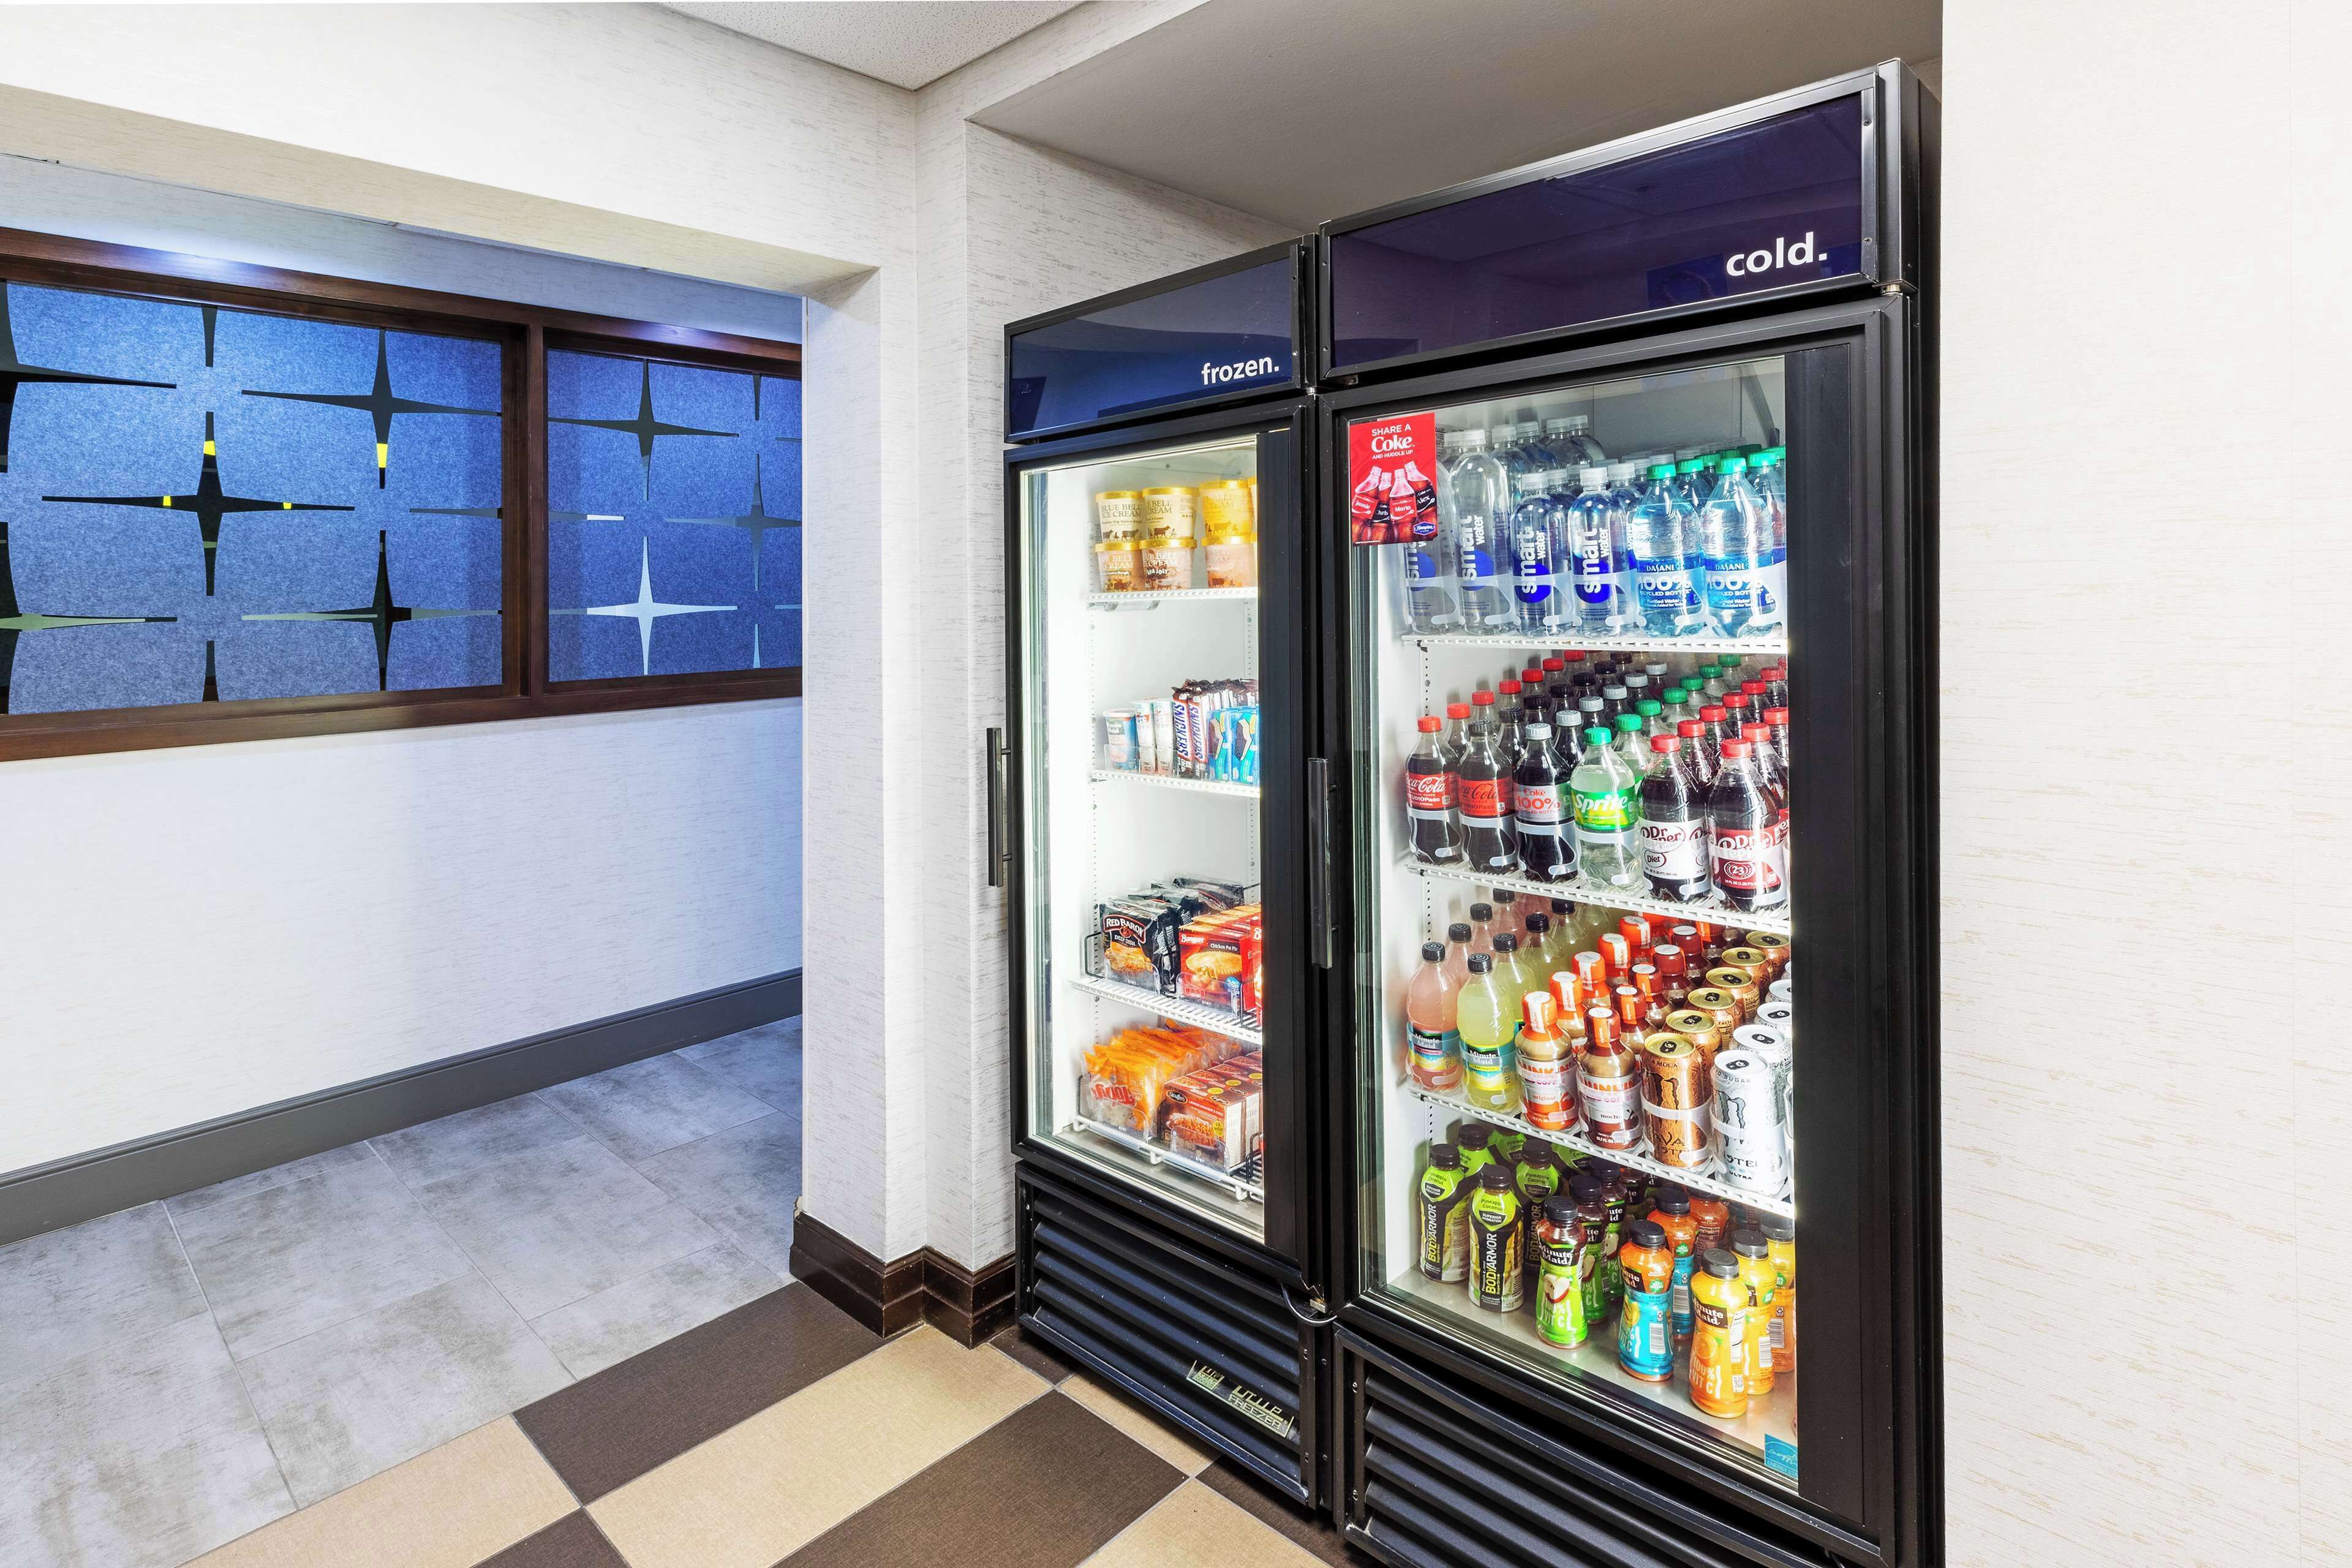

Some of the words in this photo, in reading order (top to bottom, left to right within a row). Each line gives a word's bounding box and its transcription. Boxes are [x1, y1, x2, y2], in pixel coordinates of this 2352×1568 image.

[1726, 232, 1827, 276] cold.
[1201, 356, 1280, 385] frozen.
[1372, 424, 1402, 436] SHARE
[1371, 434, 1413, 453] Coke
[1355, 500, 1371, 510] Jamie
[1474, 515, 1485, 545] water
[1460, 515, 1477, 581] smart
[1535, 530, 1546, 560] water
[1599, 527, 1610, 557] water
[1517, 530, 1537, 594] smart
[1581, 528, 1602, 594] smart
[1646, 564, 1676, 573] DASANI
[1715, 562, 1746, 571] DASANI
[1638, 575, 1692, 590] 100%
[1174, 704, 1189, 756] SNICKERS
[1189, 706, 1204, 760] SNICKERS
[1523, 788, 1546, 796] Coke
[1515, 796, 1561, 810] 100%
[1575, 793, 1628, 813] Sprite
[1649, 826, 1668, 839] Dr
[1646, 854, 1660, 863] Diet
[1731, 865, 1745, 875] 23
[1106, 918, 1120, 927] RED
[1120, 918, 1144, 937] BARON
[1181, 934, 1205, 944] Banquet
[1416, 1041, 1436, 1049] Maid
[1469, 1049, 1496, 1058] Minute
[1724, 1073, 1751, 1084] SUGAR
[1728, 1170, 1753, 1180] ULTRA
[1428, 1204, 1437, 1264] BODYARMOR
[1539, 1245, 1574, 1259] Minute
[1485, 1232, 1497, 1295] BODYARMOR
[1544, 1313, 1556, 1327] VIT
[1558, 1315, 1564, 1328] C
[1706, 1382, 1714, 1395] C
[1228, 1393, 1281, 1430] FREEZER
